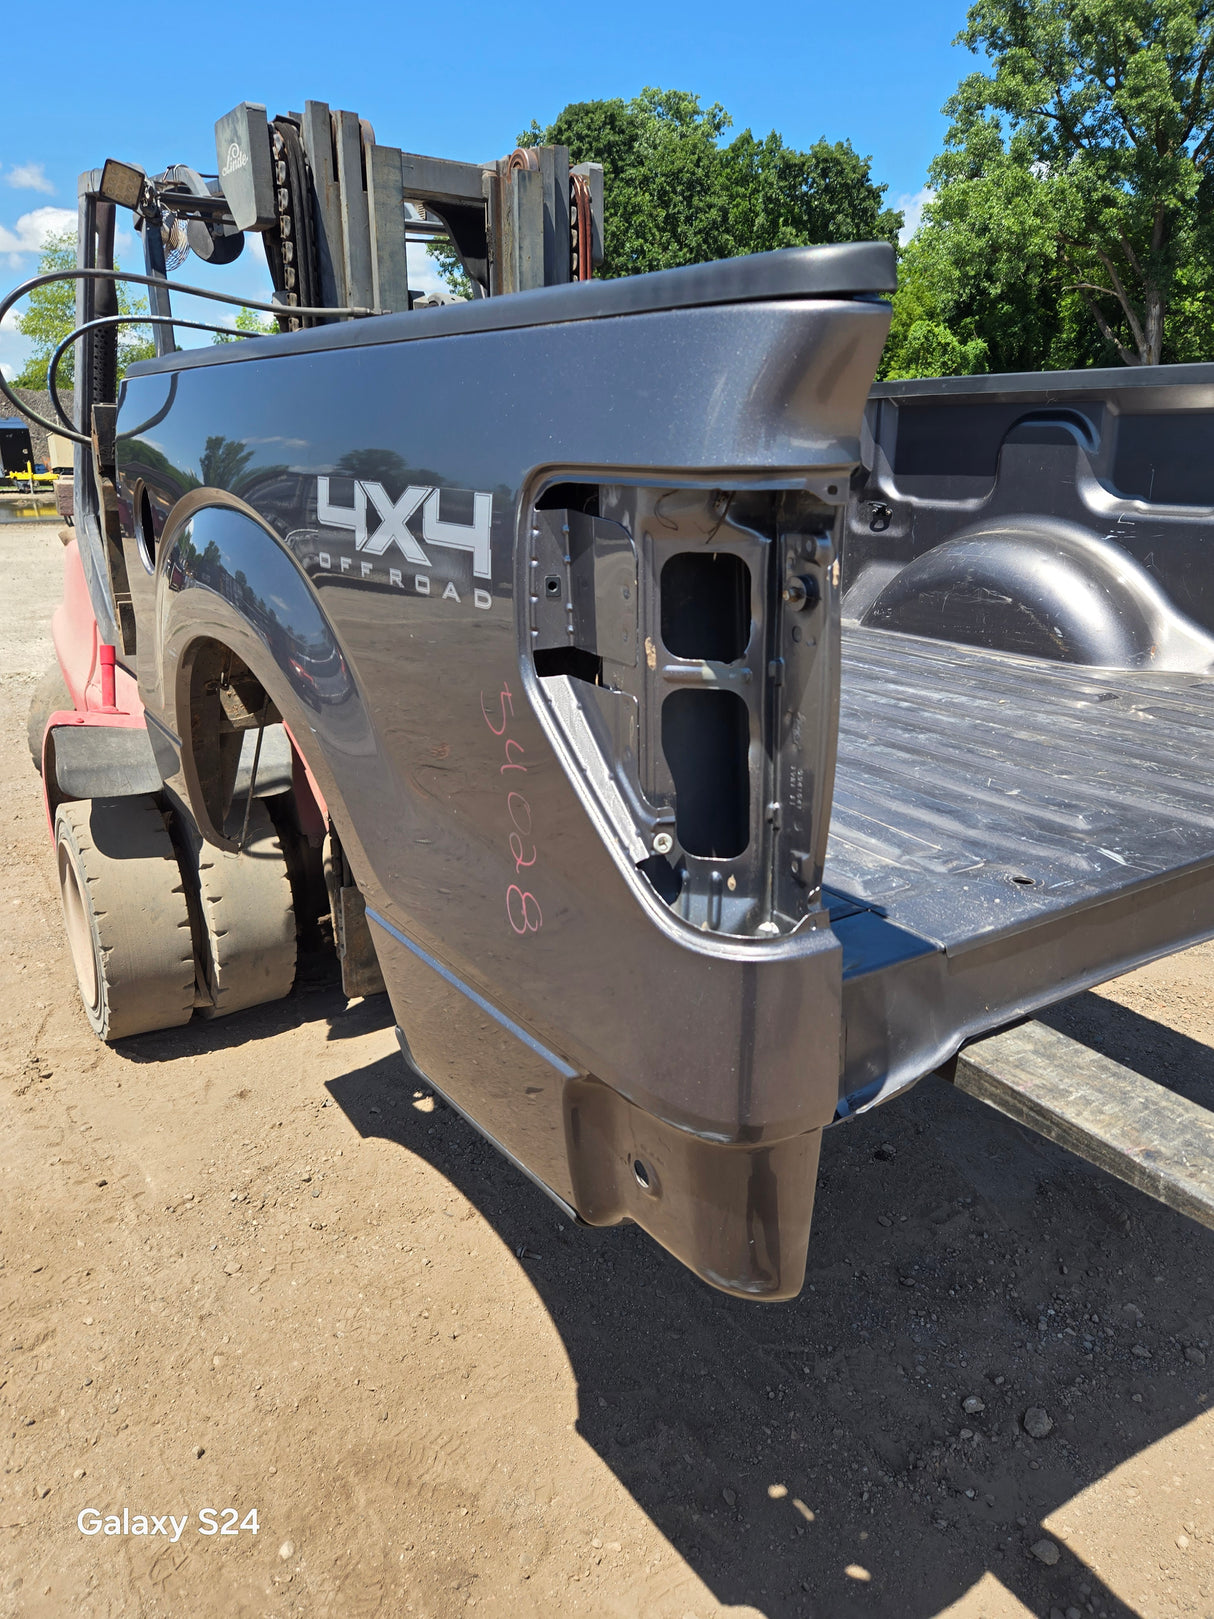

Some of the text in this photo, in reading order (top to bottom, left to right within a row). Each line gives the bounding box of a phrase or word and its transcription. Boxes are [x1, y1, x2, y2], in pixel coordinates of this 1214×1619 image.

[221, 142, 249, 177] Linde
[317, 476, 493, 580] 4X4
[480, 681, 543, 934] 54028
